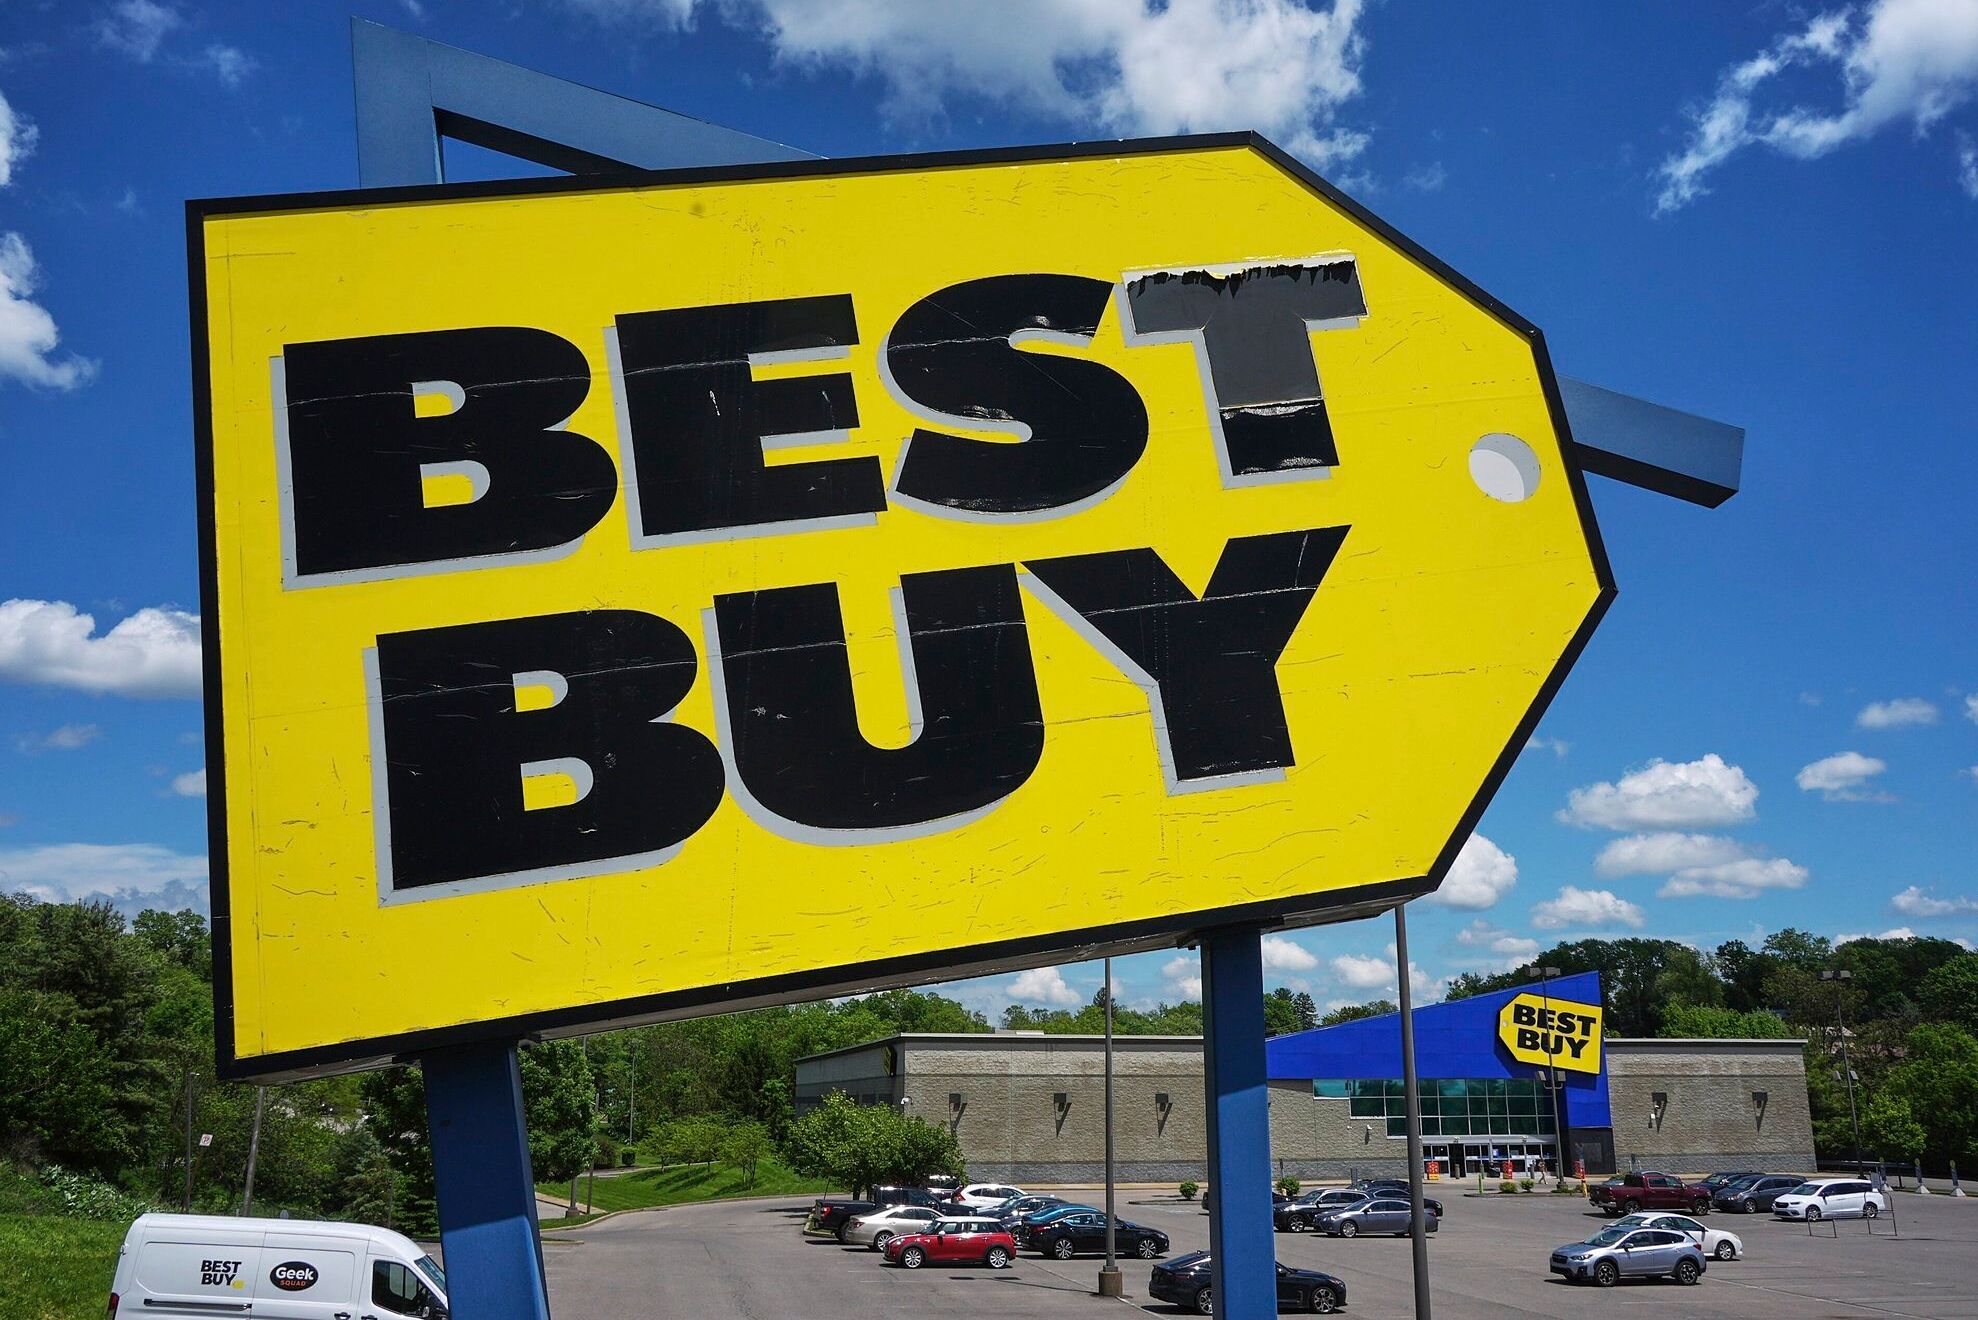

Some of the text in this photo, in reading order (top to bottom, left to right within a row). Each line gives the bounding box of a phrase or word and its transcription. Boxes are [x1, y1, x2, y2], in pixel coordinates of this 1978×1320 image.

[270, 252, 1367, 591] BEST
[368, 523, 1352, 908] BUY
[1513, 1004, 1596, 1036] BEST
[1517, 1028, 1589, 1059] BUY
[201, 1260, 241, 1273] BEST
[201, 1273, 236, 1286] BUY
[275, 1267, 314, 1280] Geek
